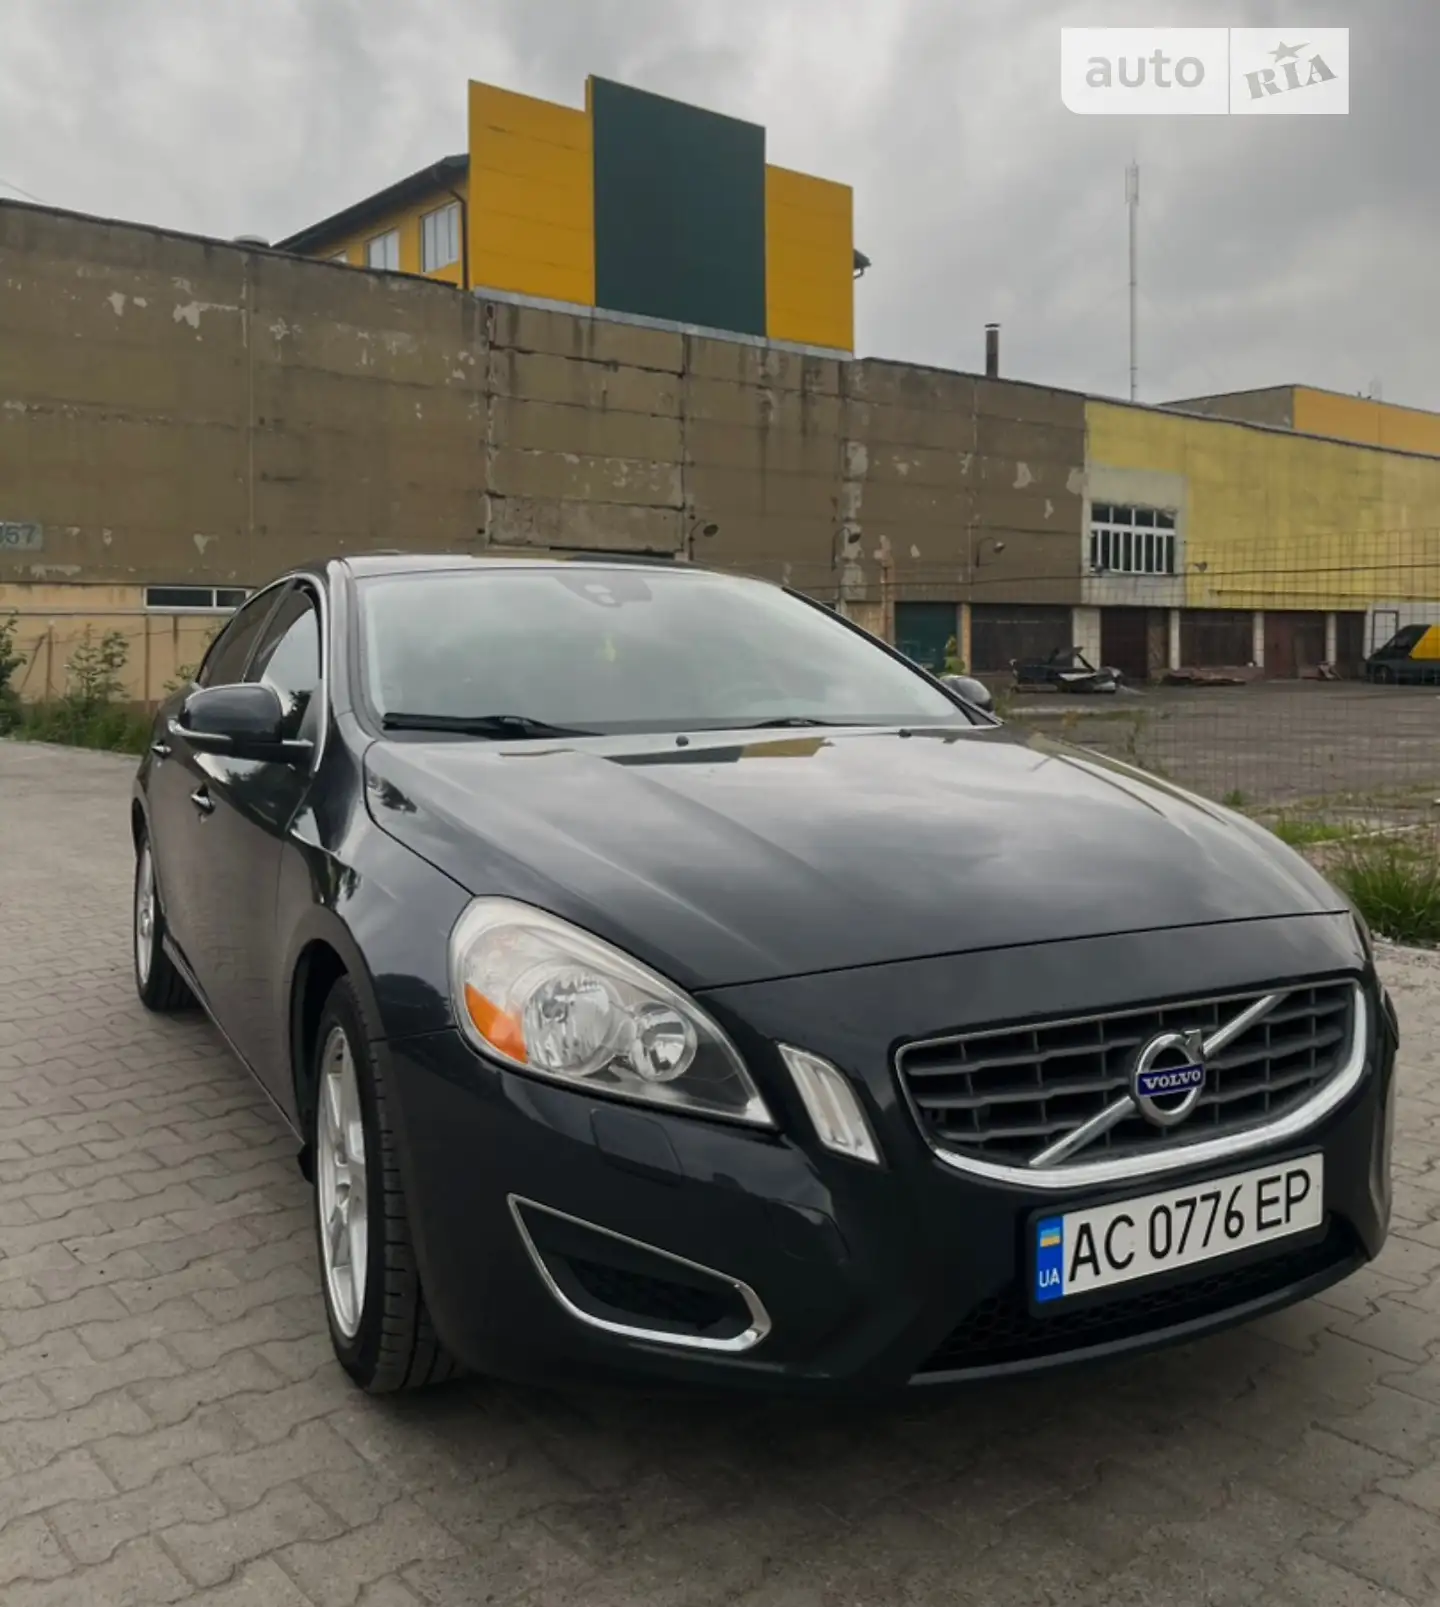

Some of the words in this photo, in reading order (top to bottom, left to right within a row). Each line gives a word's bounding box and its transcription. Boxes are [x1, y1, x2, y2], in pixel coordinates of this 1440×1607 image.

[0, 523, 36, 545] 57
[1142, 1070, 1201, 1090] VOLVO
[1068, 1213, 1136, 1282] AC
[1149, 1184, 1245, 1260] 0776
[1256, 1168, 1311, 1232] EP
[1038, 1267, 1060, 1288] UA
